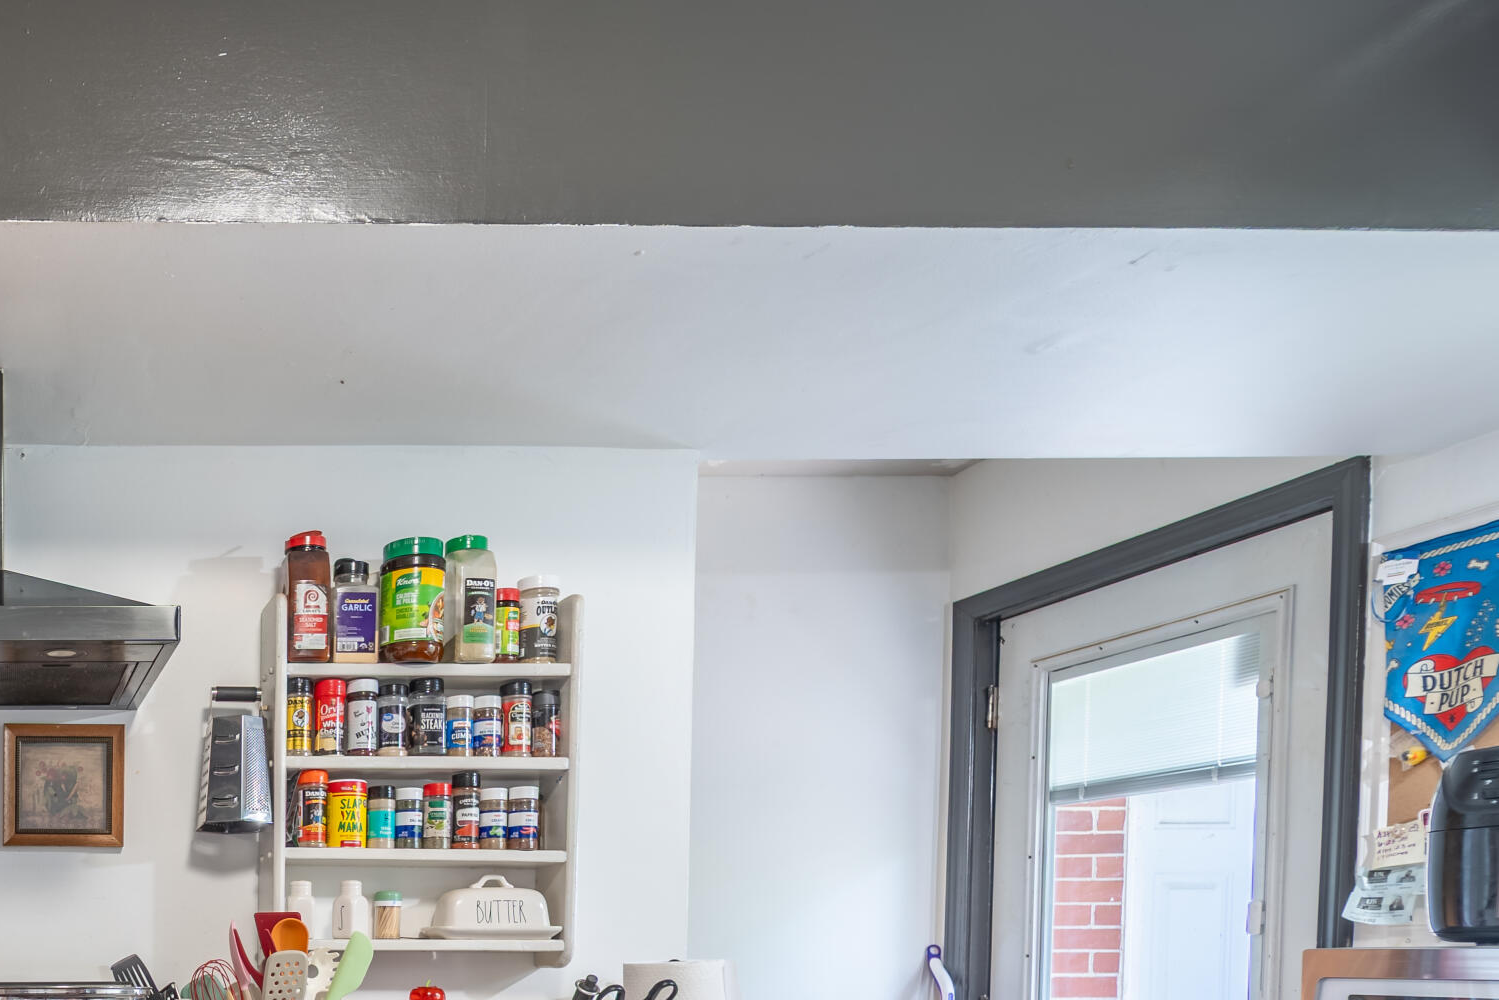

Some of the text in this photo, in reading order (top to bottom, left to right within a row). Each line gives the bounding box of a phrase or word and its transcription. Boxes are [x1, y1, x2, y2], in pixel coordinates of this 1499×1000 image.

[341, 603, 373, 612] GARLIC
[1422, 658, 1485, 692] DUTCH
[1437, 684, 1470, 712] PUP
[420, 719, 445, 730] STEAK
[340, 798, 363, 809] SLAP
[345, 810, 356, 821] YA
[337, 822, 364, 833] MAMA
[476, 899, 527, 924] BUTTER
